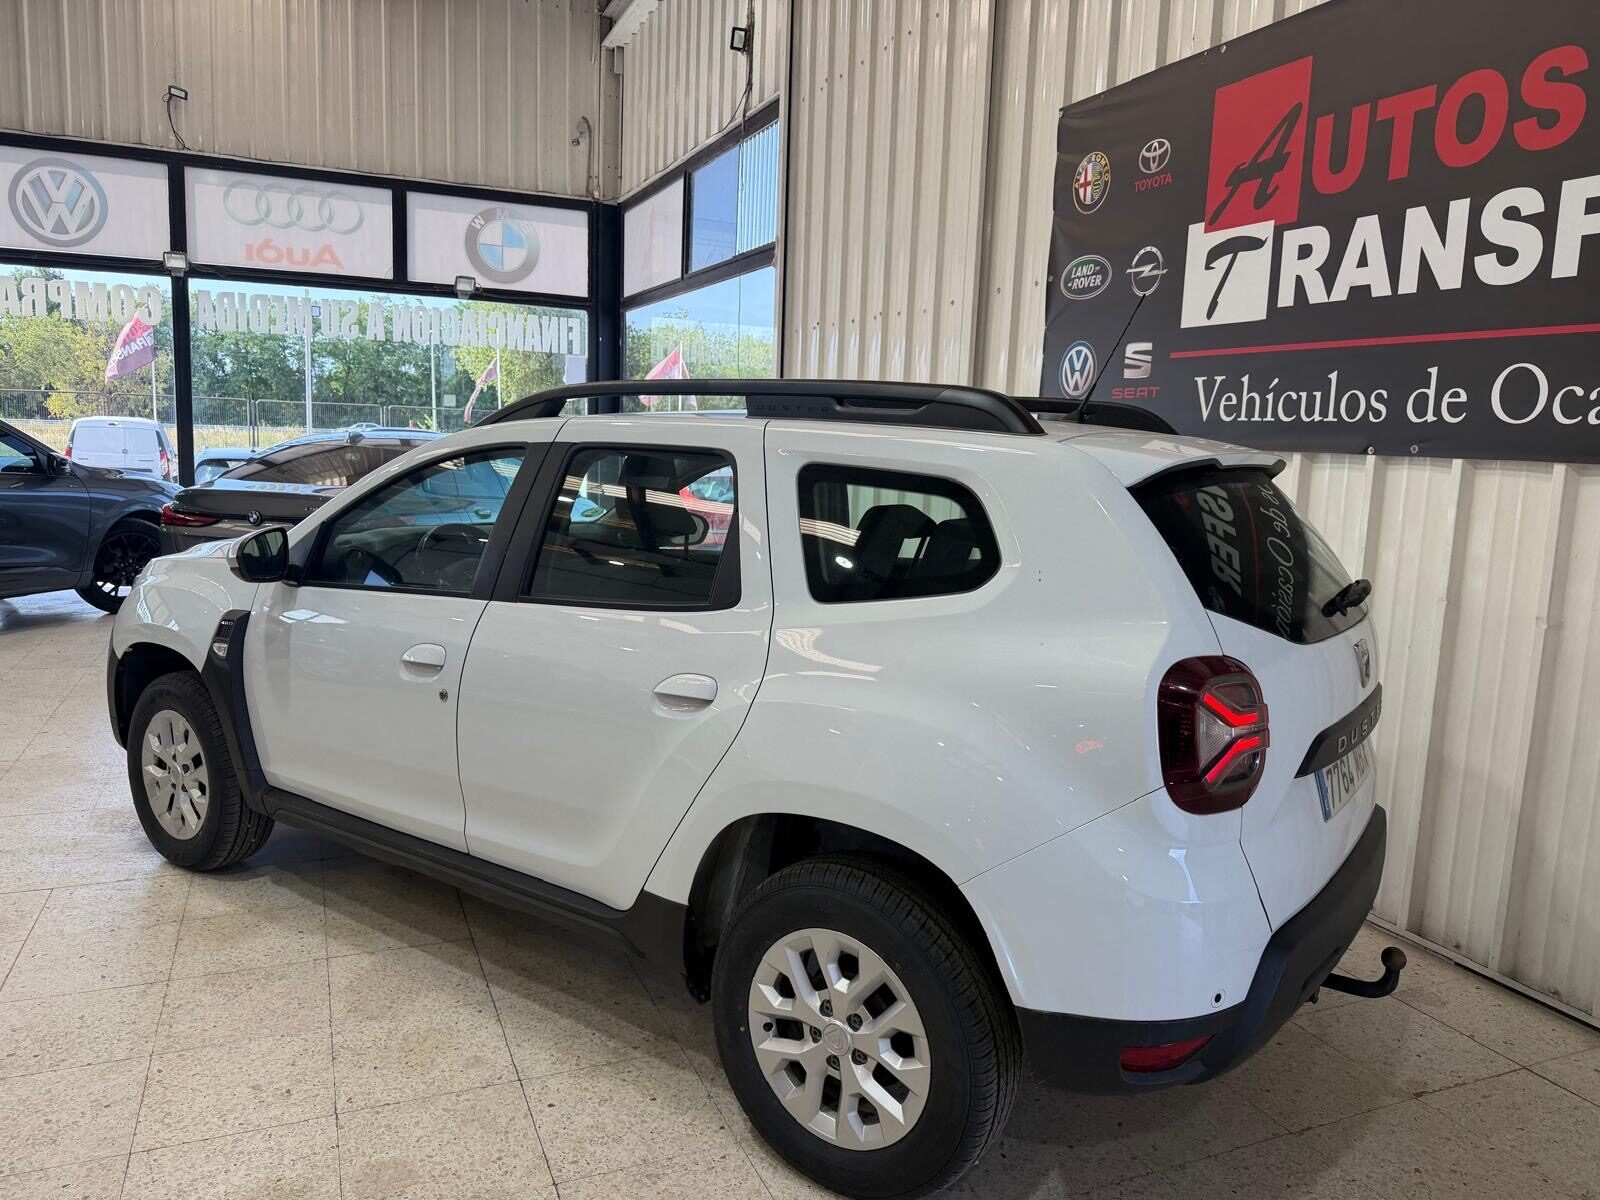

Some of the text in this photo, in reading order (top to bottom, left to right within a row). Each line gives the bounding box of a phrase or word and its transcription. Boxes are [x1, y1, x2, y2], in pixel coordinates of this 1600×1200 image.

[1207, 45, 1588, 226] AUTOS
[1134, 173, 1172, 192] TOYOTA
[1071, 263, 1095, 278] LAND
[1071, 274, 1102, 290] ROVER
[1111, 387, 1160, 399] SEAT
[1194, 370, 1388, 423] Vehículos
[1406, 366, 1468, 423] de
[1337, 704, 1381, 753] DUSTE
[1325, 752, 1356, 809] 7764
